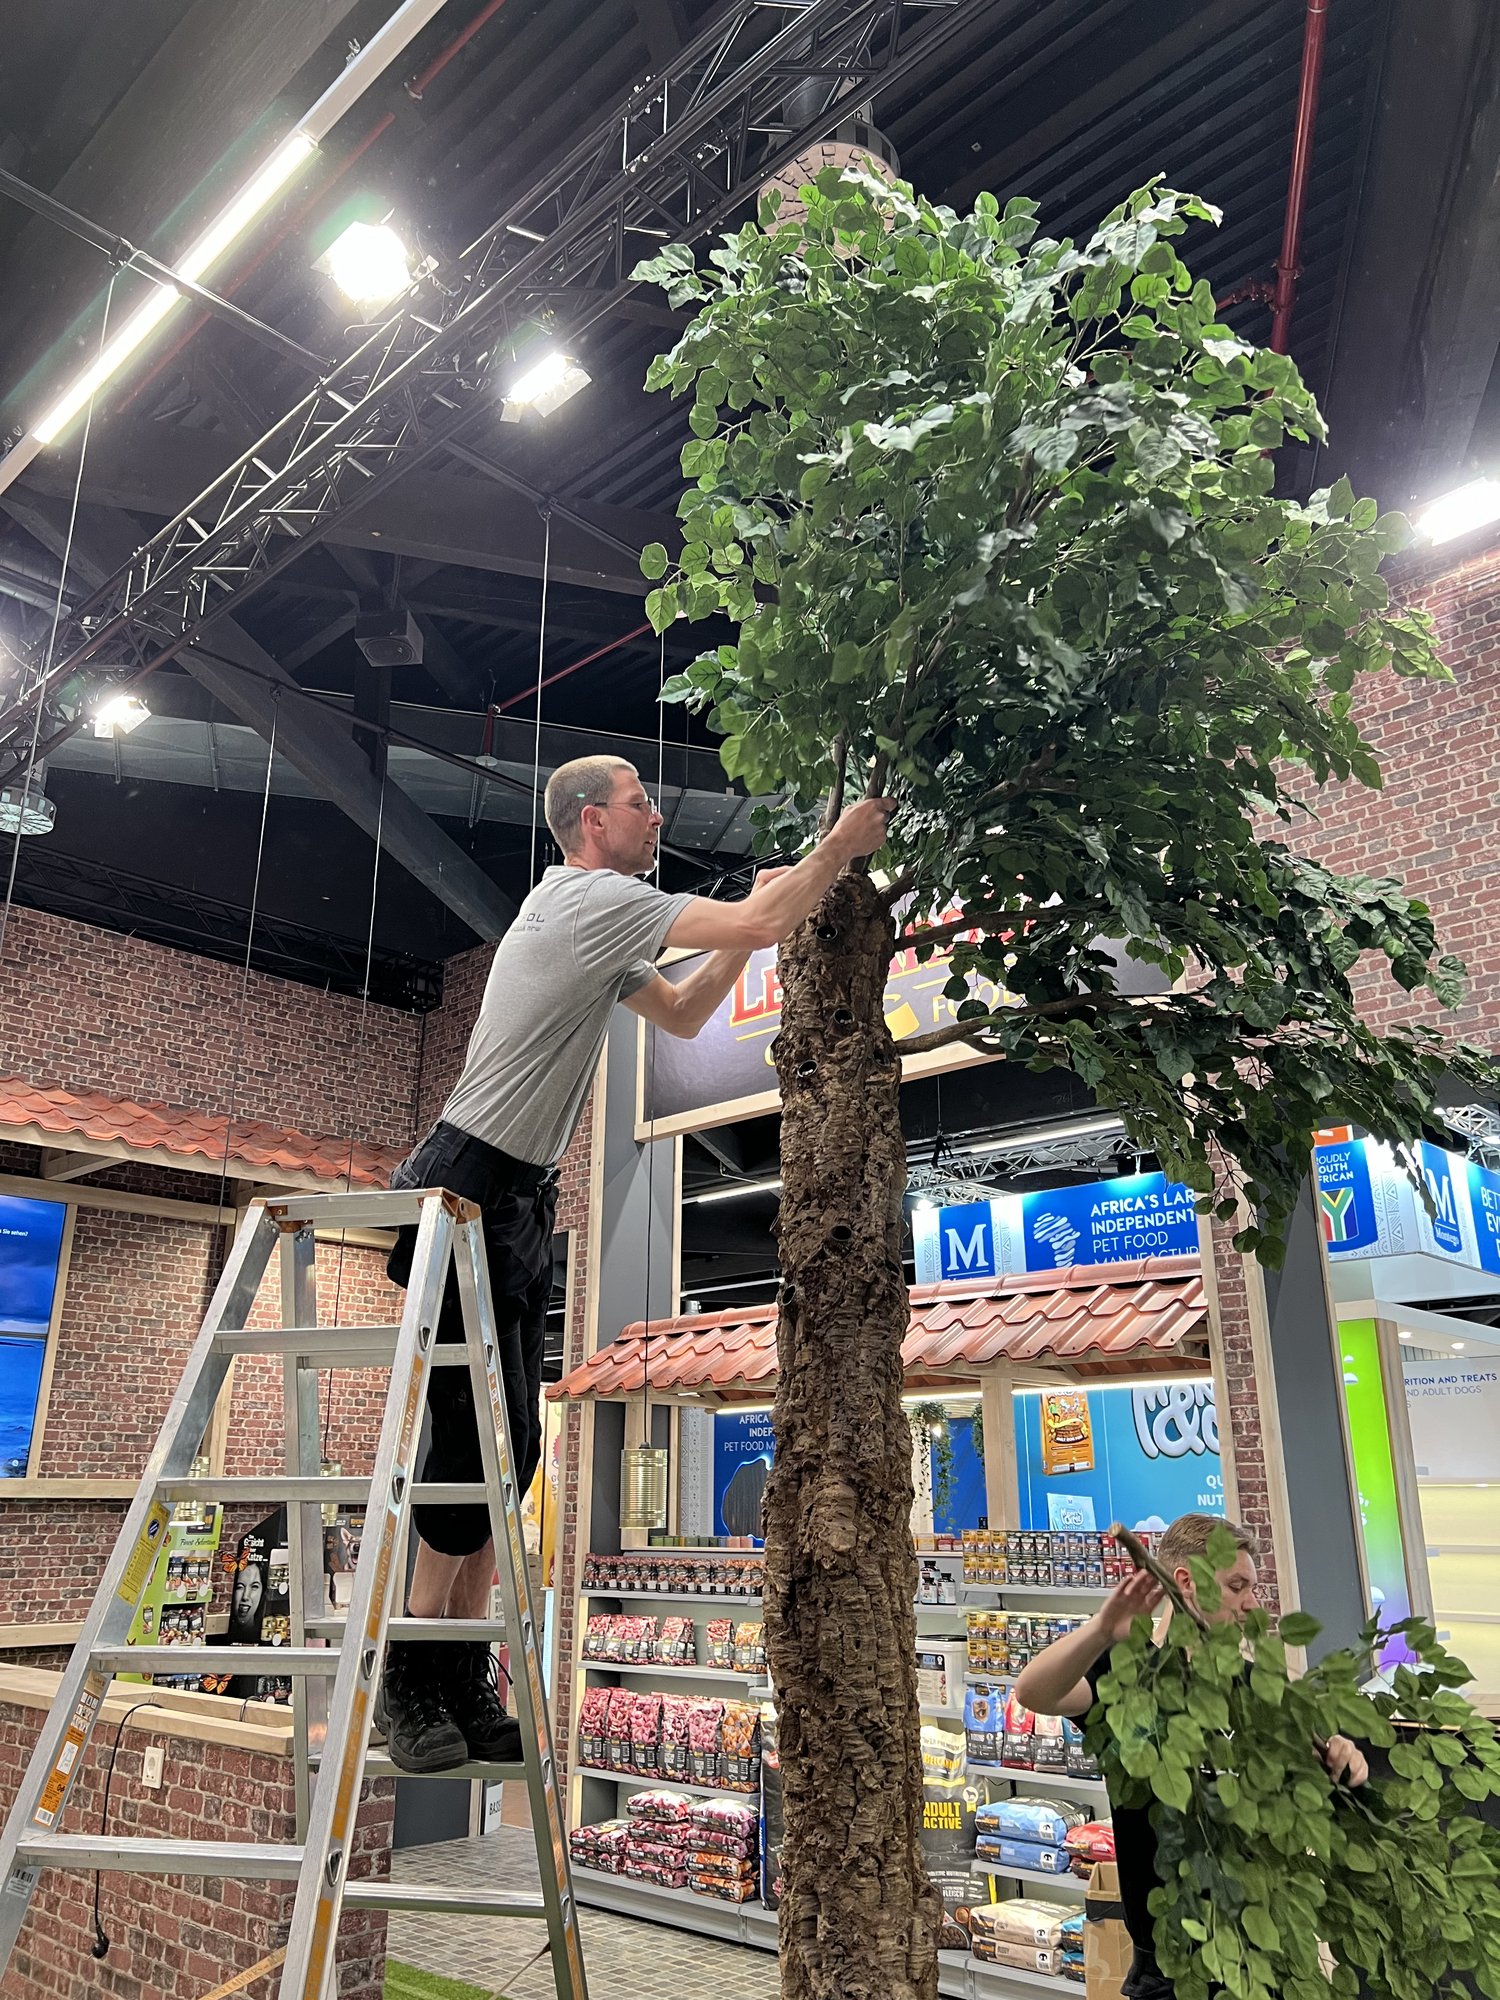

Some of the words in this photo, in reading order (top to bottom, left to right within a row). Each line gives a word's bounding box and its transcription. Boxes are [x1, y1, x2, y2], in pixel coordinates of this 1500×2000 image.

[1090, 1194, 1160, 1218] AFRICA'S
[1091, 1208, 1196, 1236] INDEPENDENT
[944, 1223, 990, 1271] M
[1092, 1236, 1120, 1254] PET
[1124, 1230, 1169, 1250] FOOD
[1404, 1377, 1435, 1386] RITION
[1437, 1375, 1458, 1385] AND
[1460, 1373, 1498, 1383] TREATS
[1421, 1386, 1453, 1396] ADULT
[1454, 1385, 1482, 1395] DOGS
[739, 1413, 770, 1425] AFRICA
[723, 1441, 739, 1452] PET
[740, 1440, 765, 1451] FOOD
[922, 1801, 961, 1818] ADULT
[923, 1817, 962, 1830] ACTIVE
